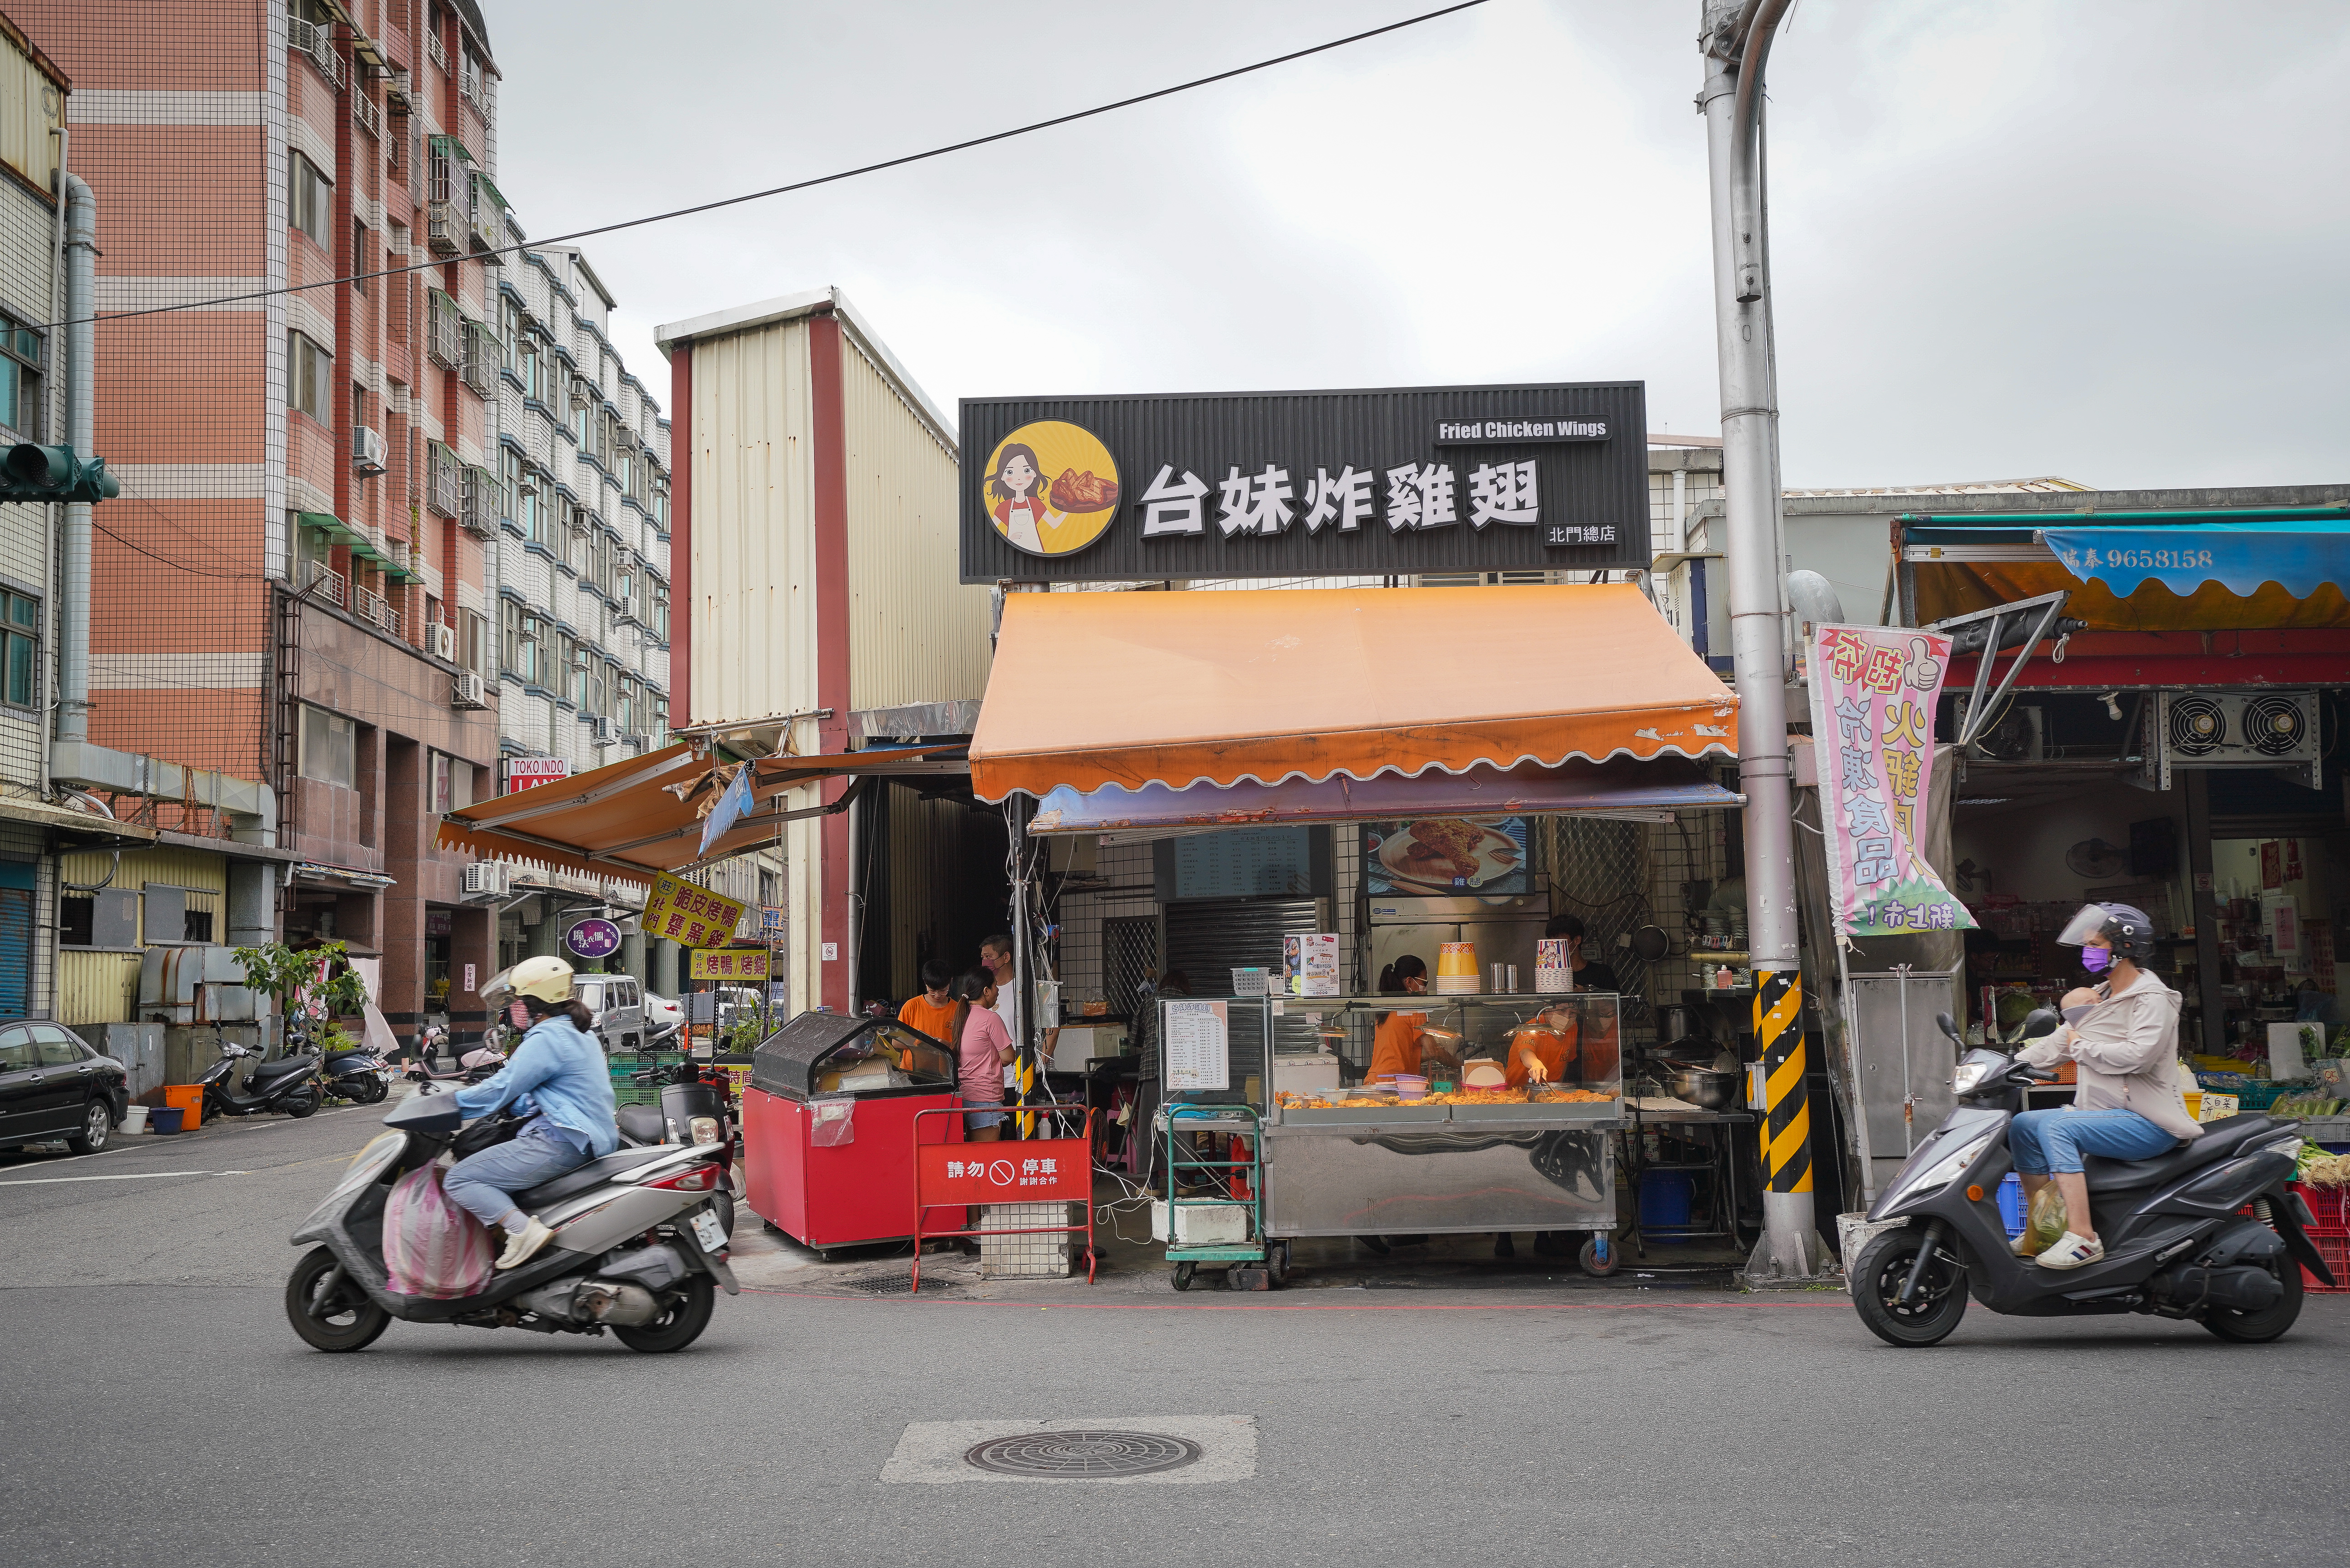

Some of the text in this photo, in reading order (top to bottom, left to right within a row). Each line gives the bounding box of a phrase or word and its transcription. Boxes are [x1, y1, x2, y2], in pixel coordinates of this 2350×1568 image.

[1440, 421, 1606, 438] Fried Chicken Wings
[1140, 459, 1541, 536] 台妹炸雞翅
[1549, 524, 1615, 543] 北門總店
[2063, 548, 2213, 568] 瑞泰 9658158
[515, 760, 563, 774] TOKO INDO
[1454, 877, 1481, 886] 雞腿
[646, 897, 666, 929] 北門
[673, 885, 738, 928] 脆皮烤鴨
[572, 930, 604, 948] 魔法衣櫥
[664, 912, 726, 948] 甕窯雞
[695, 962, 703, 978] 北門
[706, 954, 766, 975] 烤鴨/烤雞
[1172, 1003, 1210, 1012] 台妹炸雞翅
[2202, 1095, 2231, 1110] 大白菜
[947, 1158, 1058, 1178] 請勿 停車
[1019, 1176, 1058, 1186] 謝謝合作
